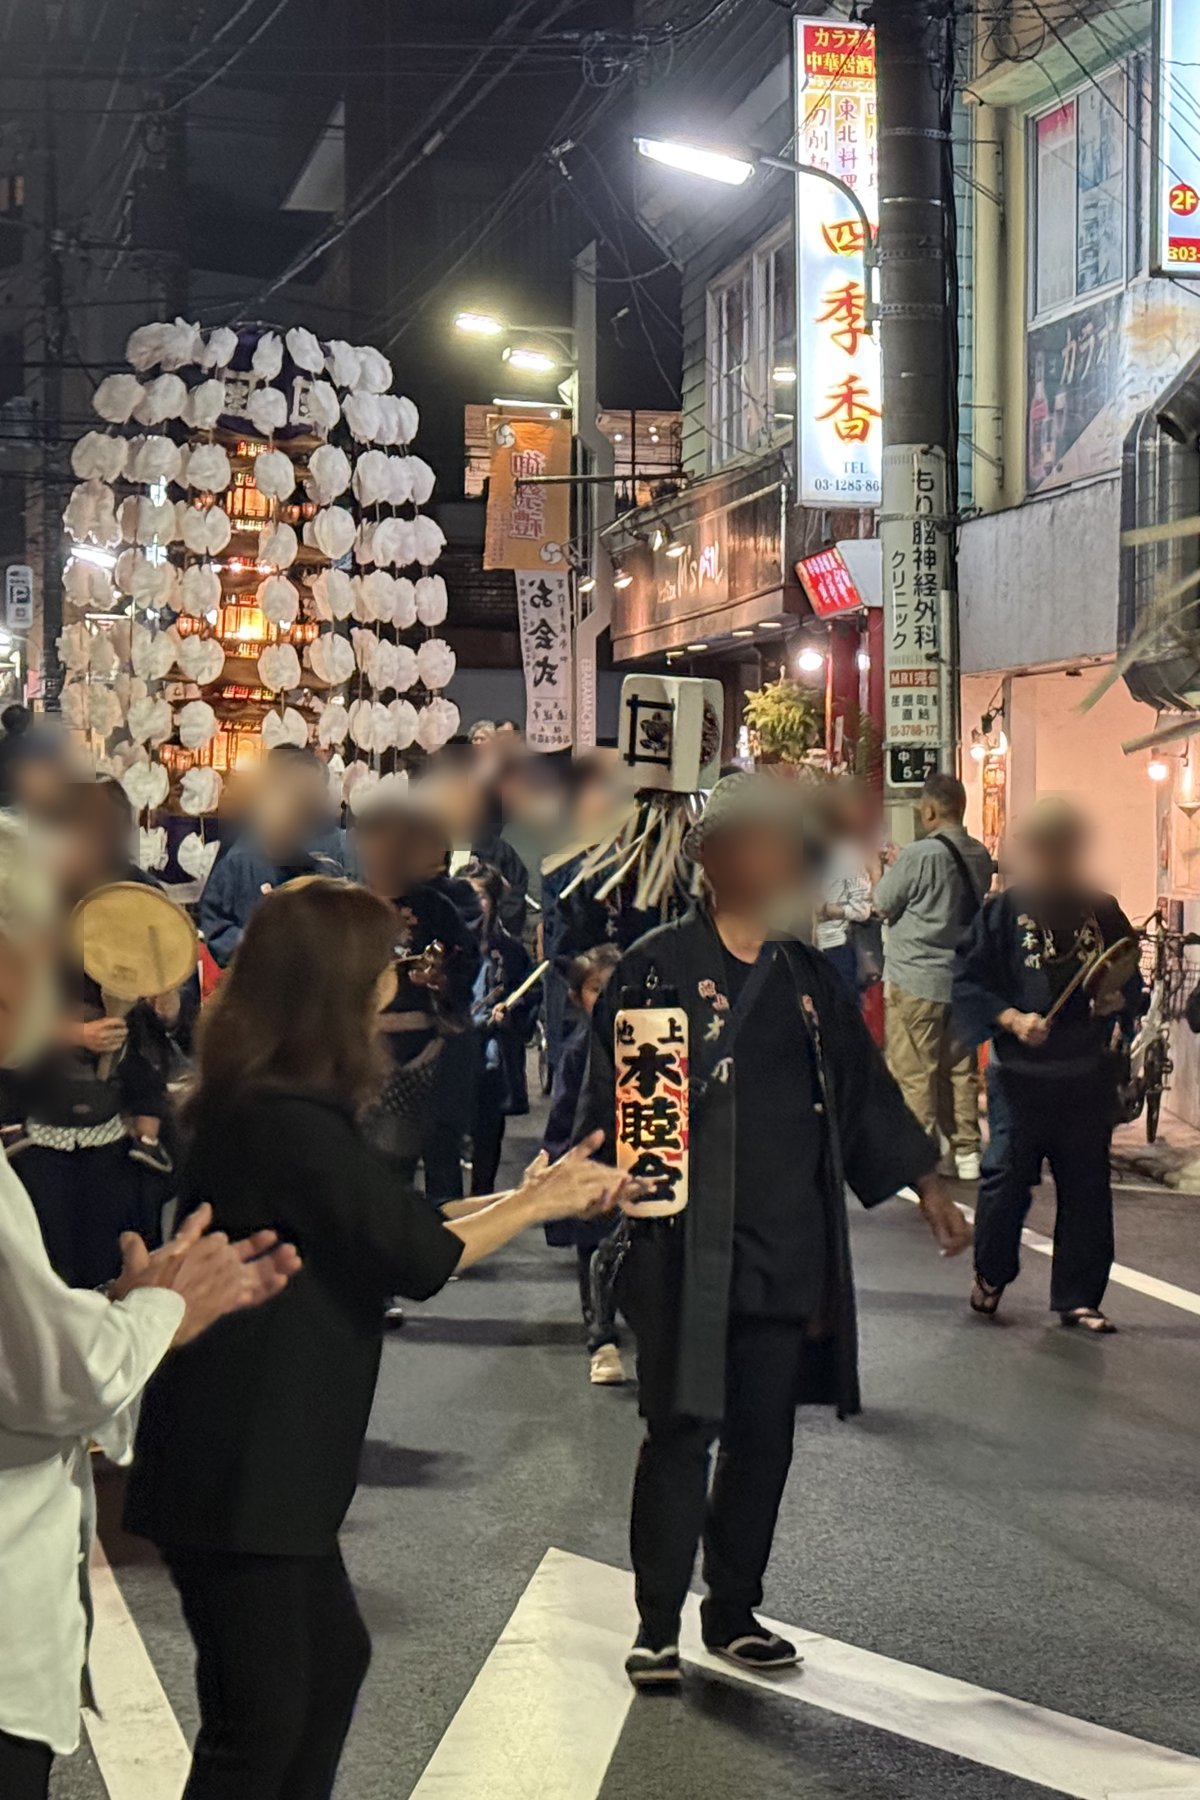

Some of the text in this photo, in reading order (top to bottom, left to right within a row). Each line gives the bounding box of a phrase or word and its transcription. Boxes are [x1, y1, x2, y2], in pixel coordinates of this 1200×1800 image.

[1171, 190, 1197, 210] 2F
[814, 220, 882, 443] 四季香
[891, 550, 908, 650] クリニック
[912, 468, 937, 649] もり脳神経外科
